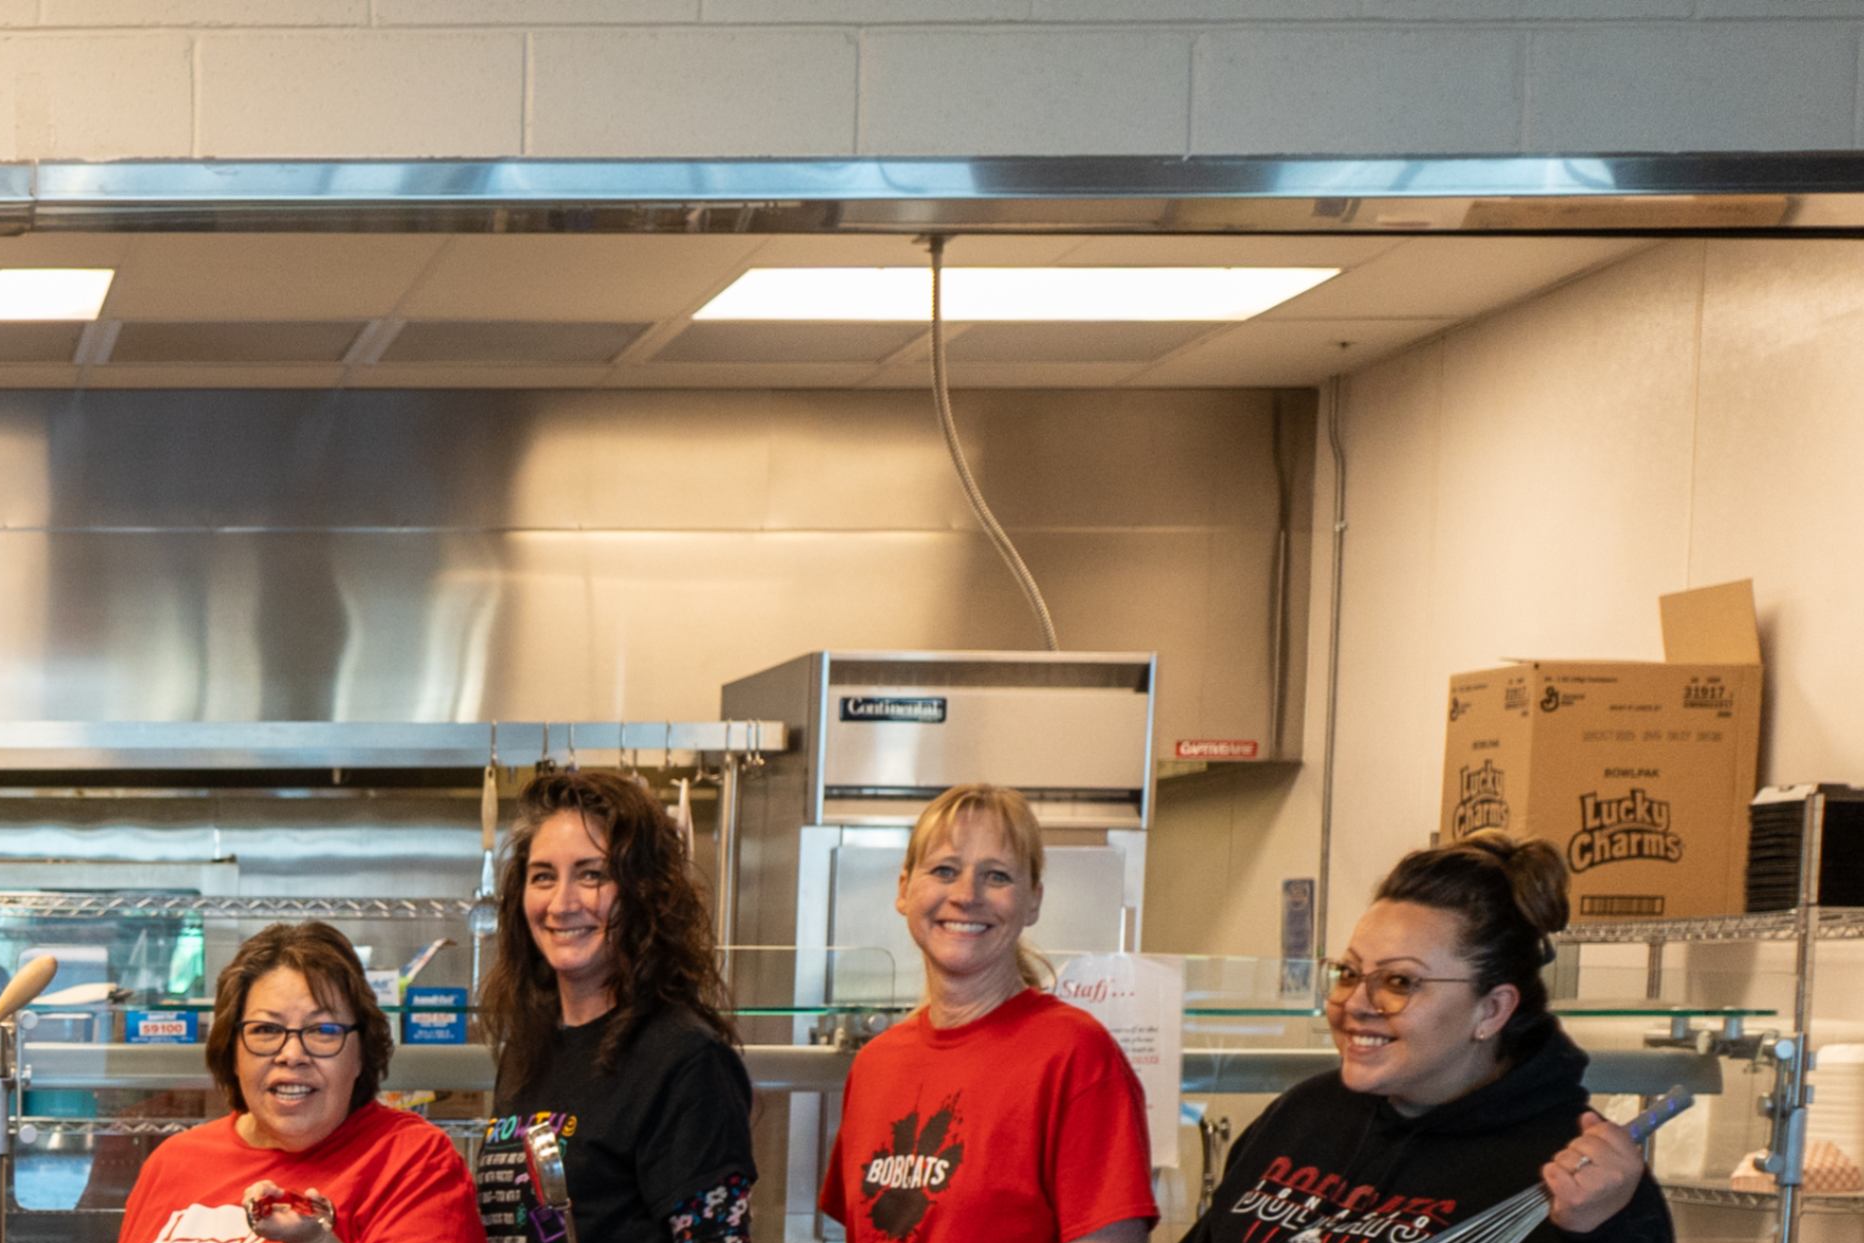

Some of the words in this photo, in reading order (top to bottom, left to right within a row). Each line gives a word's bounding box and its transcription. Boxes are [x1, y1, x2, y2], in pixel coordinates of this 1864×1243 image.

[1580, 788, 1670, 833] Lucky
[1568, 830, 1683, 874] Charms
[866, 1154, 950, 1189] BOBCATS
